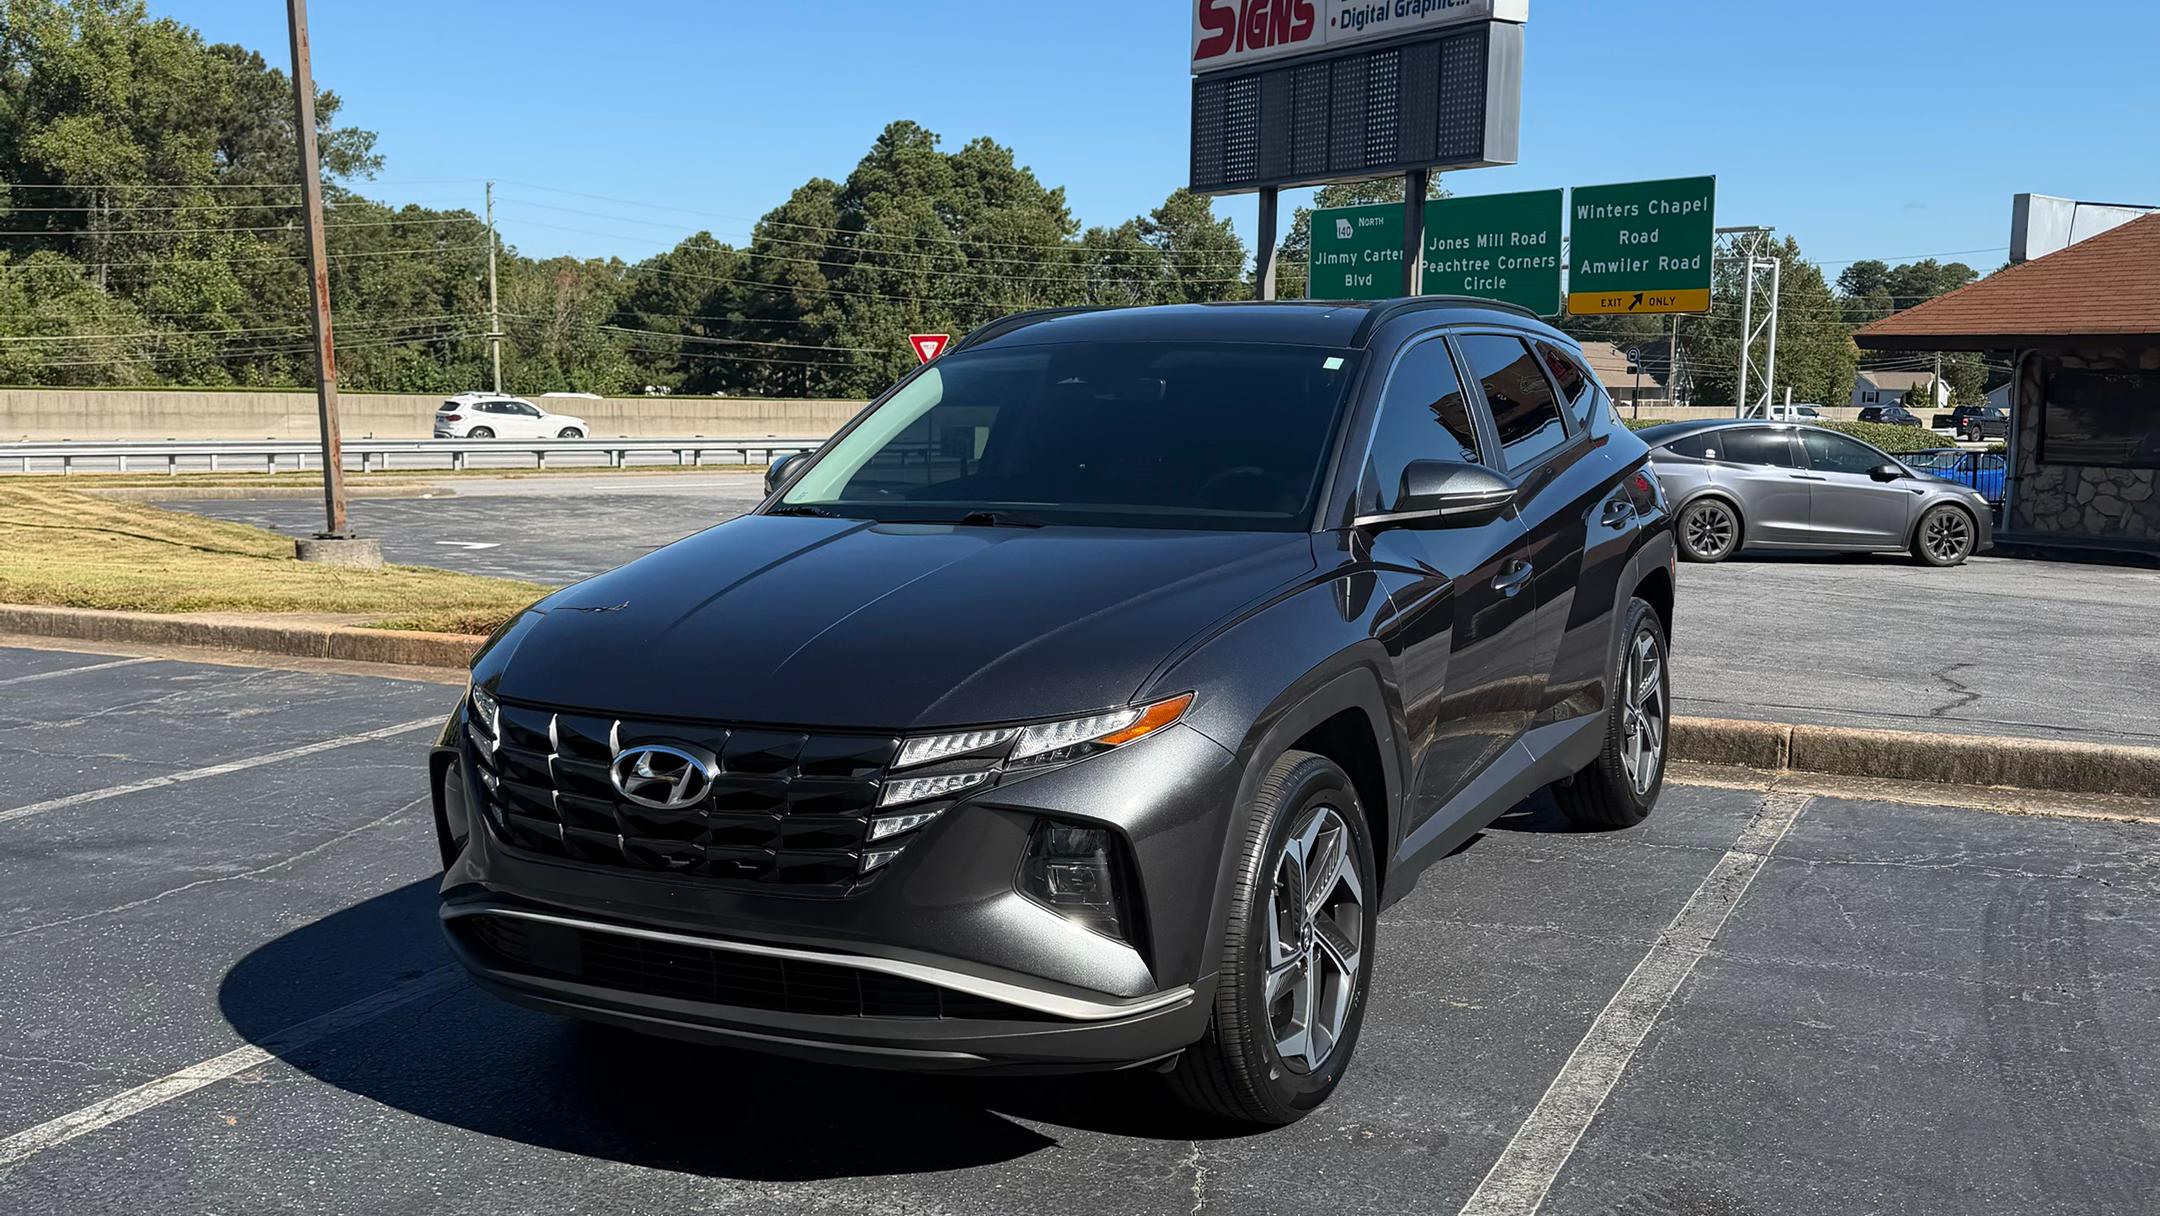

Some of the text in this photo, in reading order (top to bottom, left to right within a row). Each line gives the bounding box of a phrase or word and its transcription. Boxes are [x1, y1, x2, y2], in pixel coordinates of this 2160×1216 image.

[1340, 0, 1390, 31] Digital
[1194, 0, 1315, 60] SIGNS
[1577, 196, 1707, 219] Winters Chapel
[1358, 217, 1384, 227] NORTH
[1338, 225, 1351, 237] 140
[1619, 228, 1659, 245] Road
[1429, 231, 1547, 251] Jones Mill Road
[1315, 251, 1358, 266] Jimmy
[1498, 255, 1555, 269] Corners
[1580, 254, 1701, 275] Amwiler Road
[1345, 273, 1373, 287] Blvd
[1464, 276, 1507, 290] Circle
[1601, 297, 1676, 308] EXIT ONLY
